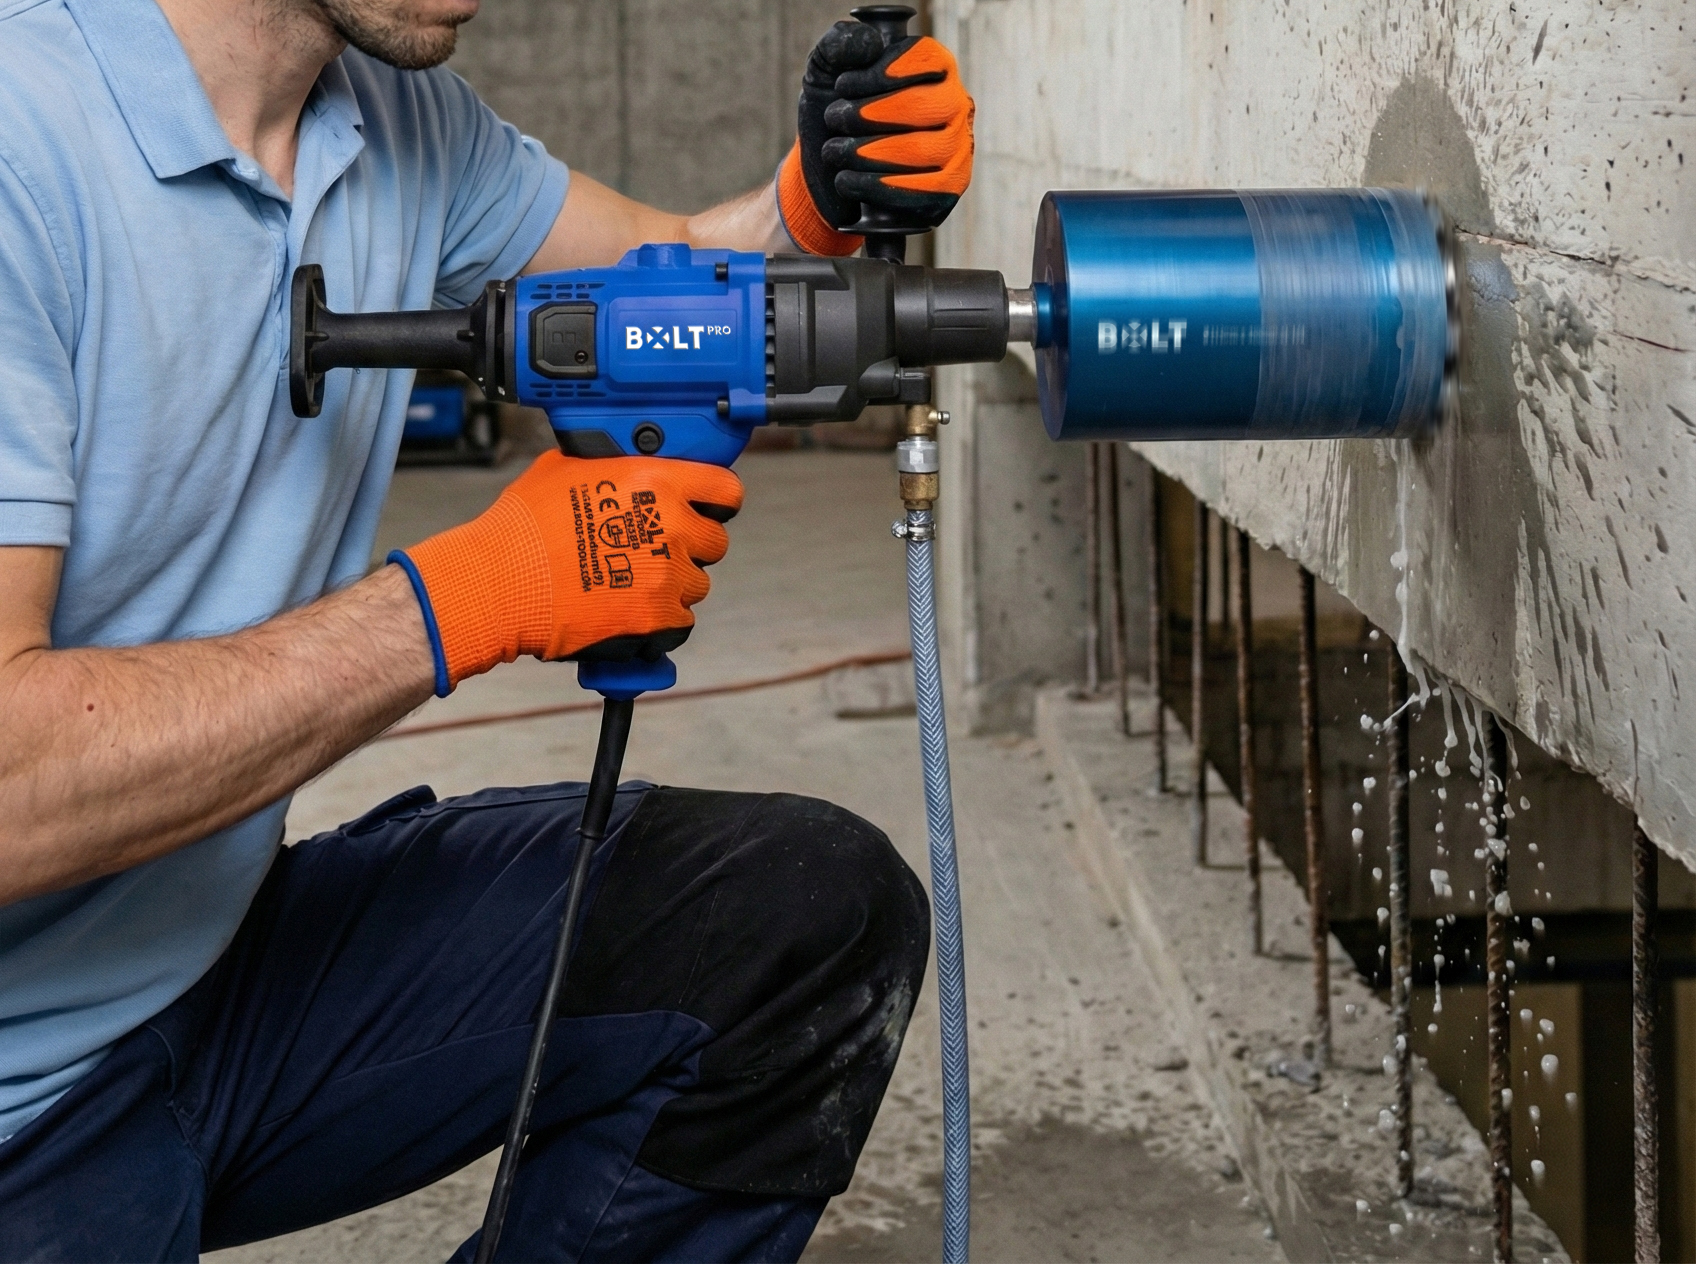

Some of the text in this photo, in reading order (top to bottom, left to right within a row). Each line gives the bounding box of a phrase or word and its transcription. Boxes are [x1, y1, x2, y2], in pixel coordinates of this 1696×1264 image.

[626, 325, 731, 350] BOLT PRO
[1098, 319, 1187, 354] BOLT
[639, 490, 671, 560] BOLT
